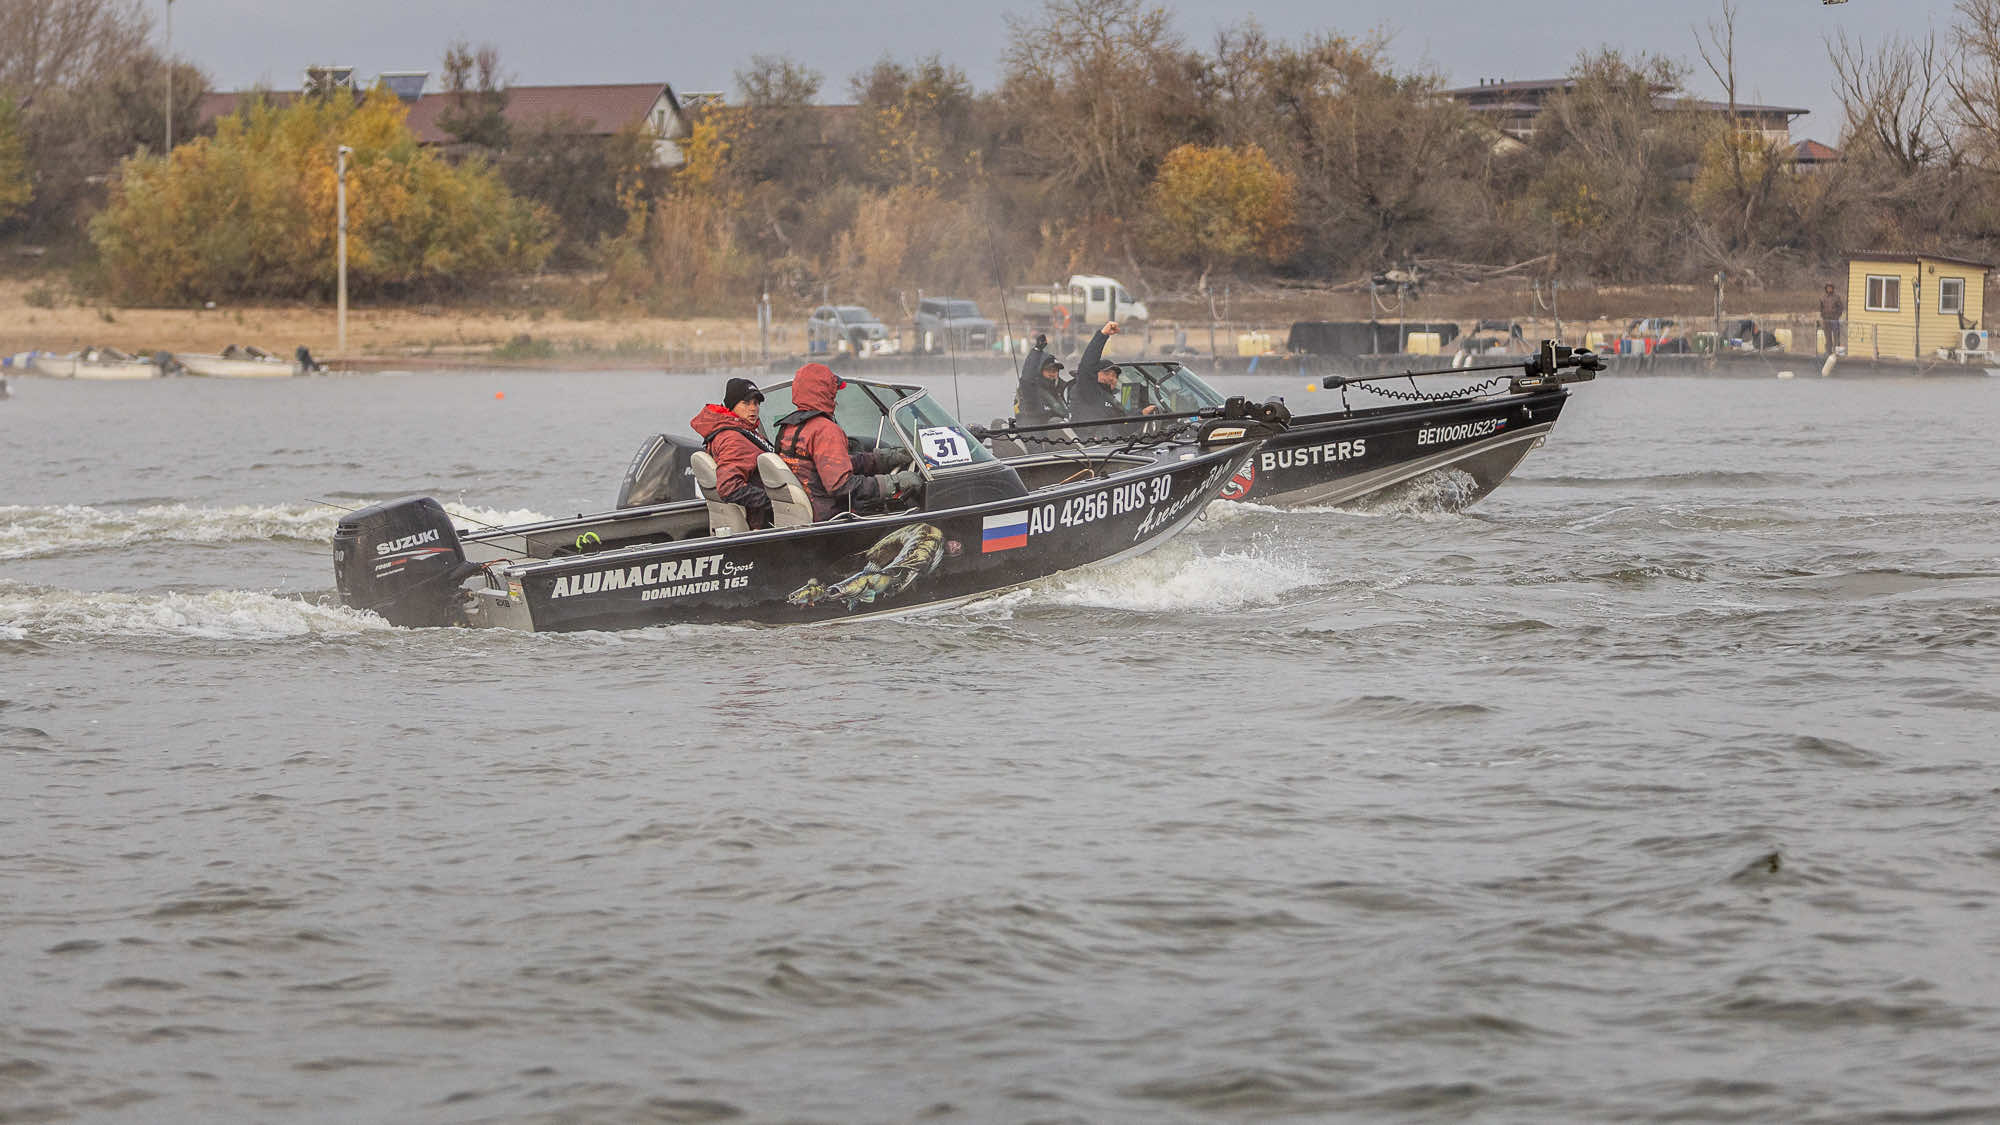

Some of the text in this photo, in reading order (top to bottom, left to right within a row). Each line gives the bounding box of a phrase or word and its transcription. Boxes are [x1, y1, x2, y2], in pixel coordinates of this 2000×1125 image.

[1417, 418, 1497, 445] BE1100RUS23
[934, 438, 958, 457] 31
[1261, 439, 1366, 471] BUSTERS
[1060, 491, 1108, 527] 4256
[1112, 481, 1146, 515] RUS
[1149, 474, 1172, 504] 30
[376, 528, 440, 555] SUZUKI
[551, 553, 755, 599] ALUMACRAFT Sport
[641, 575, 749, 601] DOMINATOR 165
